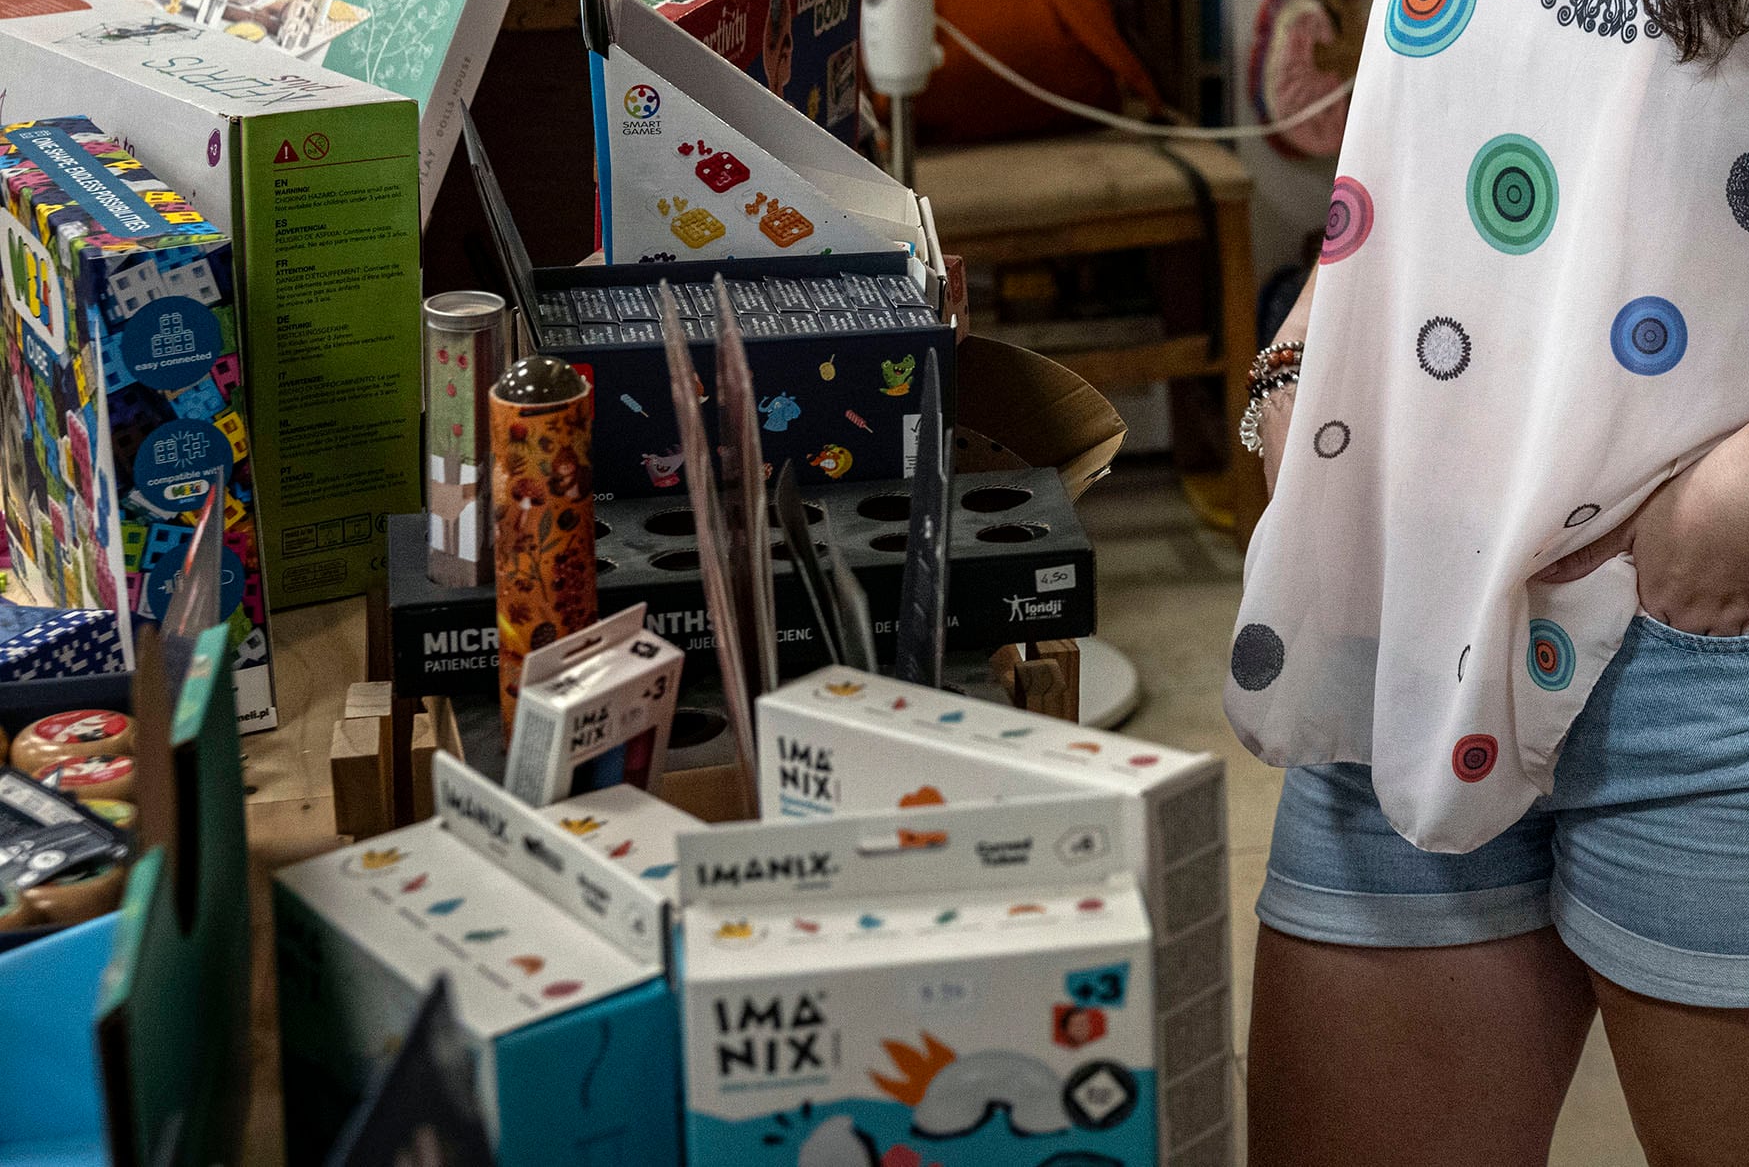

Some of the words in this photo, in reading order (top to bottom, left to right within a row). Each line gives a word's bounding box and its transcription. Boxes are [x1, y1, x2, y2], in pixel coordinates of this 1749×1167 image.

[452, 54, 473, 100] HOUSE
[622, 128, 662, 136] GAMES
[32, 137, 54, 154] ONE
[65, 164, 103, 195] ENDLESS
[275, 179, 288, 187] EN
[275, 186, 310, 195] WARNING!
[275, 219, 288, 228] ES
[276, 259, 288, 267] FR
[277, 315, 290, 324] DE
[135, 362, 159, 371] easy
[160, 352, 212, 367] connected
[147, 470, 201, 486] compatible
[280, 467, 291, 475] PT
[1025, 600, 1062, 615] londji
[875, 622, 891, 634] DE
[423, 627, 500, 655] MICR
[424, 658, 487, 673] PATIENCE
[778, 737, 834, 772] IMA
[778, 768, 832, 801] NIX
[697, 852, 833, 887] IMANIX
[714, 993, 823, 1033] IMA
[717, 1034, 823, 1076] NIX
